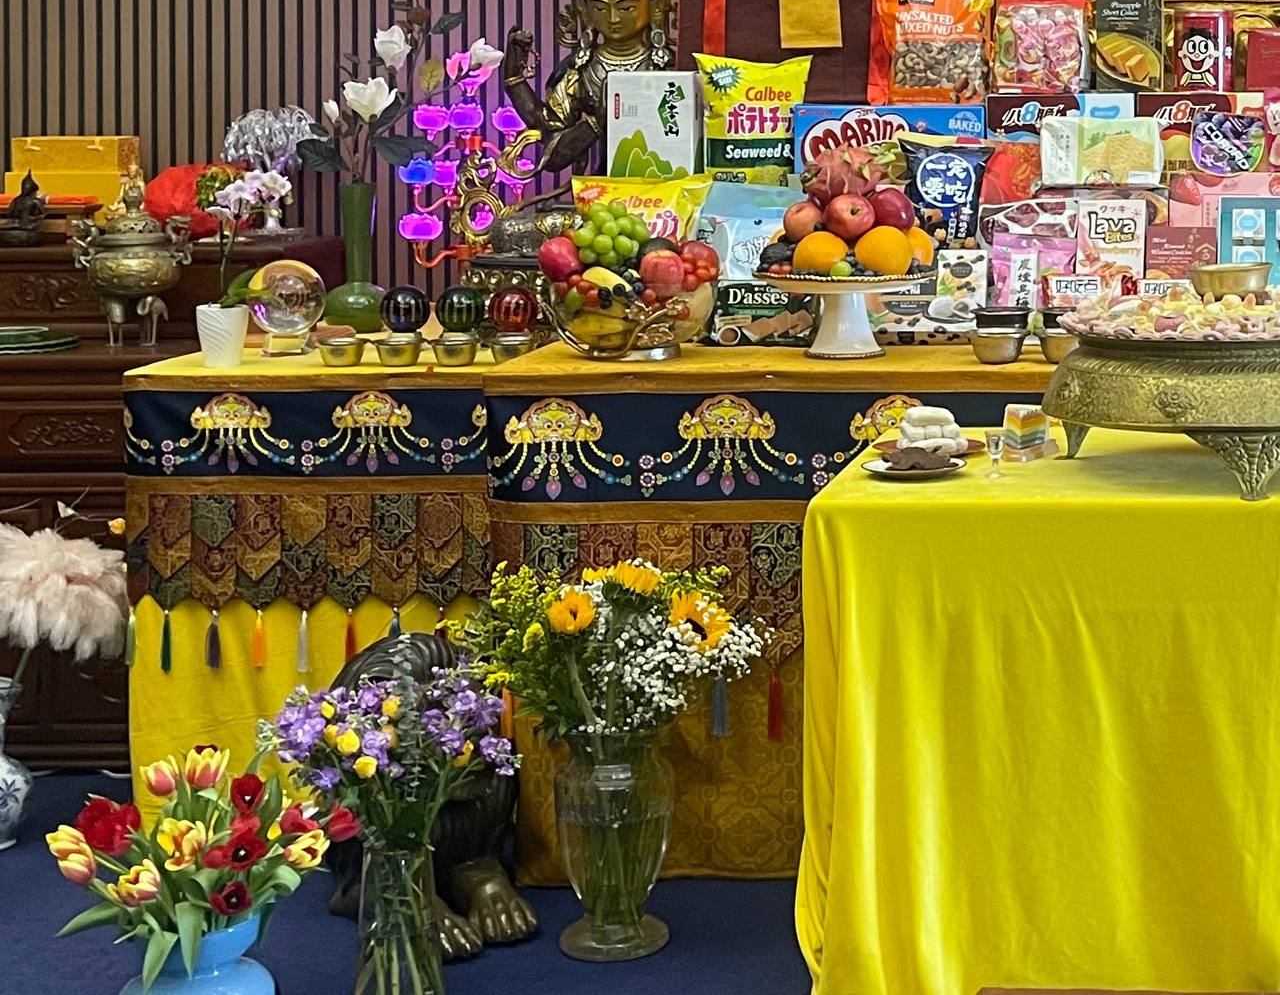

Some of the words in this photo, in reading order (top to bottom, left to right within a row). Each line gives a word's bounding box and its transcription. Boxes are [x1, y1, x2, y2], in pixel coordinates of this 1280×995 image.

[745, 86, 792, 102] Calbee
[727, 103, 794, 135] ポテトチッ
[949, 118, 981, 133] BAKED
[725, 143, 782, 159] Seaweed
[783, 144, 795, 159] &
[1088, 211, 1137, 239] Lava
[1104, 231, 1134, 244] Bites
[727, 287, 789, 305] D'asses
